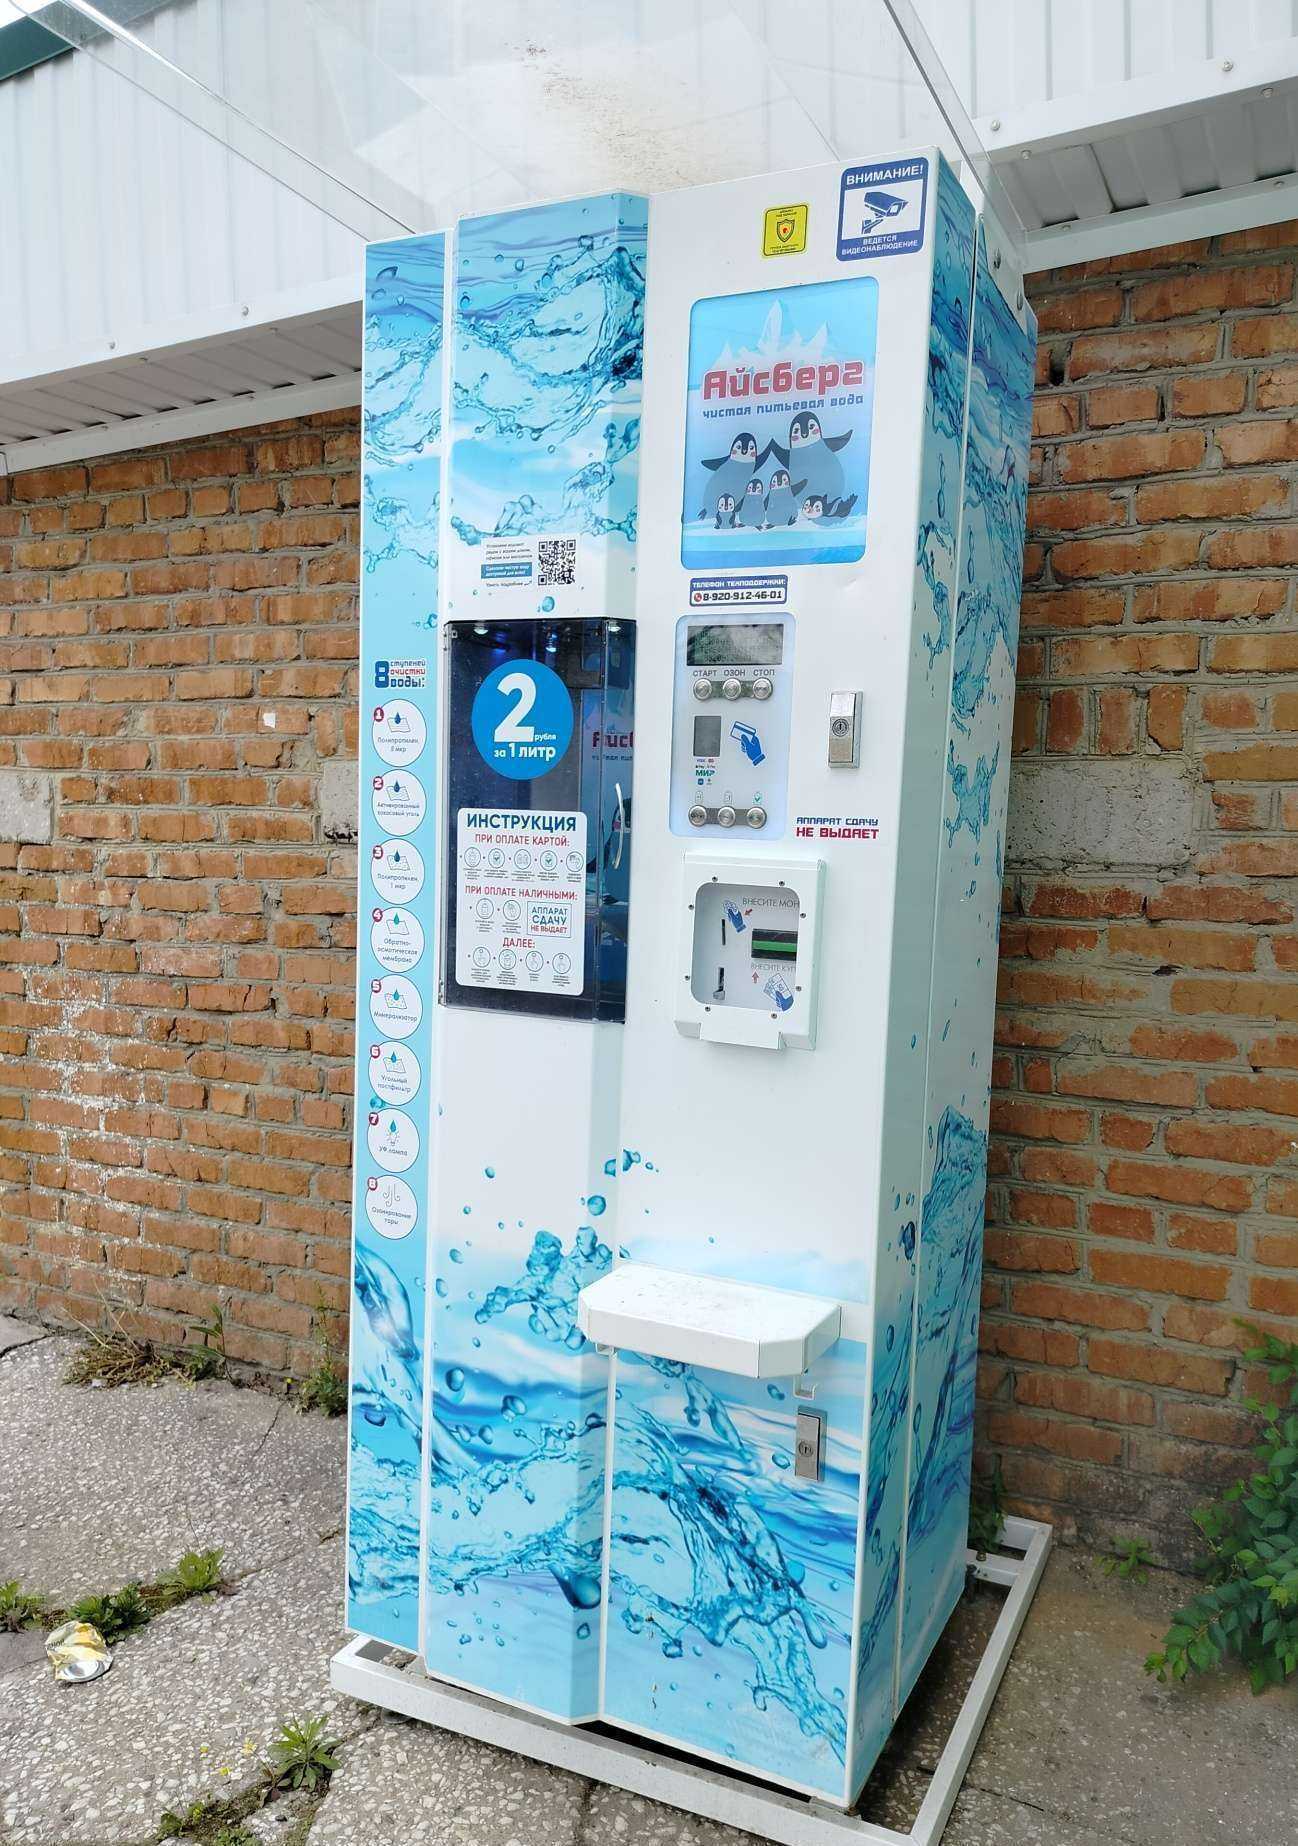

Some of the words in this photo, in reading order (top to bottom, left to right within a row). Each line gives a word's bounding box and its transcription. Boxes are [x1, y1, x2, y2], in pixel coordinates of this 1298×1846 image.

[846, 165, 924, 185] ВНИМАНИЕ!
[863, 235, 897, 245] ВЕДЕТСЯ
[841, 240, 918, 256] ВИДЕОНАБЛЮДЕНИЕ
[702, 406, 751, 418] чистая
[756, 399, 825, 414] питьевая
[830, 394, 864, 407] вода
[703, 590, 782, 601] 8-920-912-46-01
[390, 660, 425, 668] ступеней
[375, 661, 389, 688] 8
[390, 676, 425, 687] воды:
[494, 672, 536, 743] 2
[375, 709, 382, 719] 1
[534, 734, 556, 742] рубля
[494, 749, 506, 757] за
[508, 743, 516, 757] 1
[518, 745, 556, 761] литр
[375, 778, 382, 788] 2
[467, 813, 576, 833] ИНСТРУКЦИЯ
[796, 816, 841, 826] АППАРАТ
[845, 817, 879, 826] СДАЧУ
[796, 827, 814, 837] НЕ
[820, 827, 879, 839] ВЫДАЕТ
[475, 834, 493, 843] ПРИ
[496, 835, 529, 845] ОПЛАТЕ
[532, 835, 570, 847] КАРТОЙ:
[465, 885, 481, 894] ПРИ
[484, 887, 516, 897] ОПЛАТЕ
[519, 888, 578, 900] НАЛИЧНЫМИ:
[742, 897, 778, 907] ВНЕСИТЕ
[374, 910, 381, 920] 4
[531, 906, 568, 915] АППАРАТ
[532, 915, 567, 925] СДАЧУ
[541, 925, 568, 934] ВЫДАЕТ
[502, 937, 535, 948] ДАЛЕЕ:
[751, 963, 781, 971] ВНЕСИТЕ
[370, 1113, 378, 1124] 7
